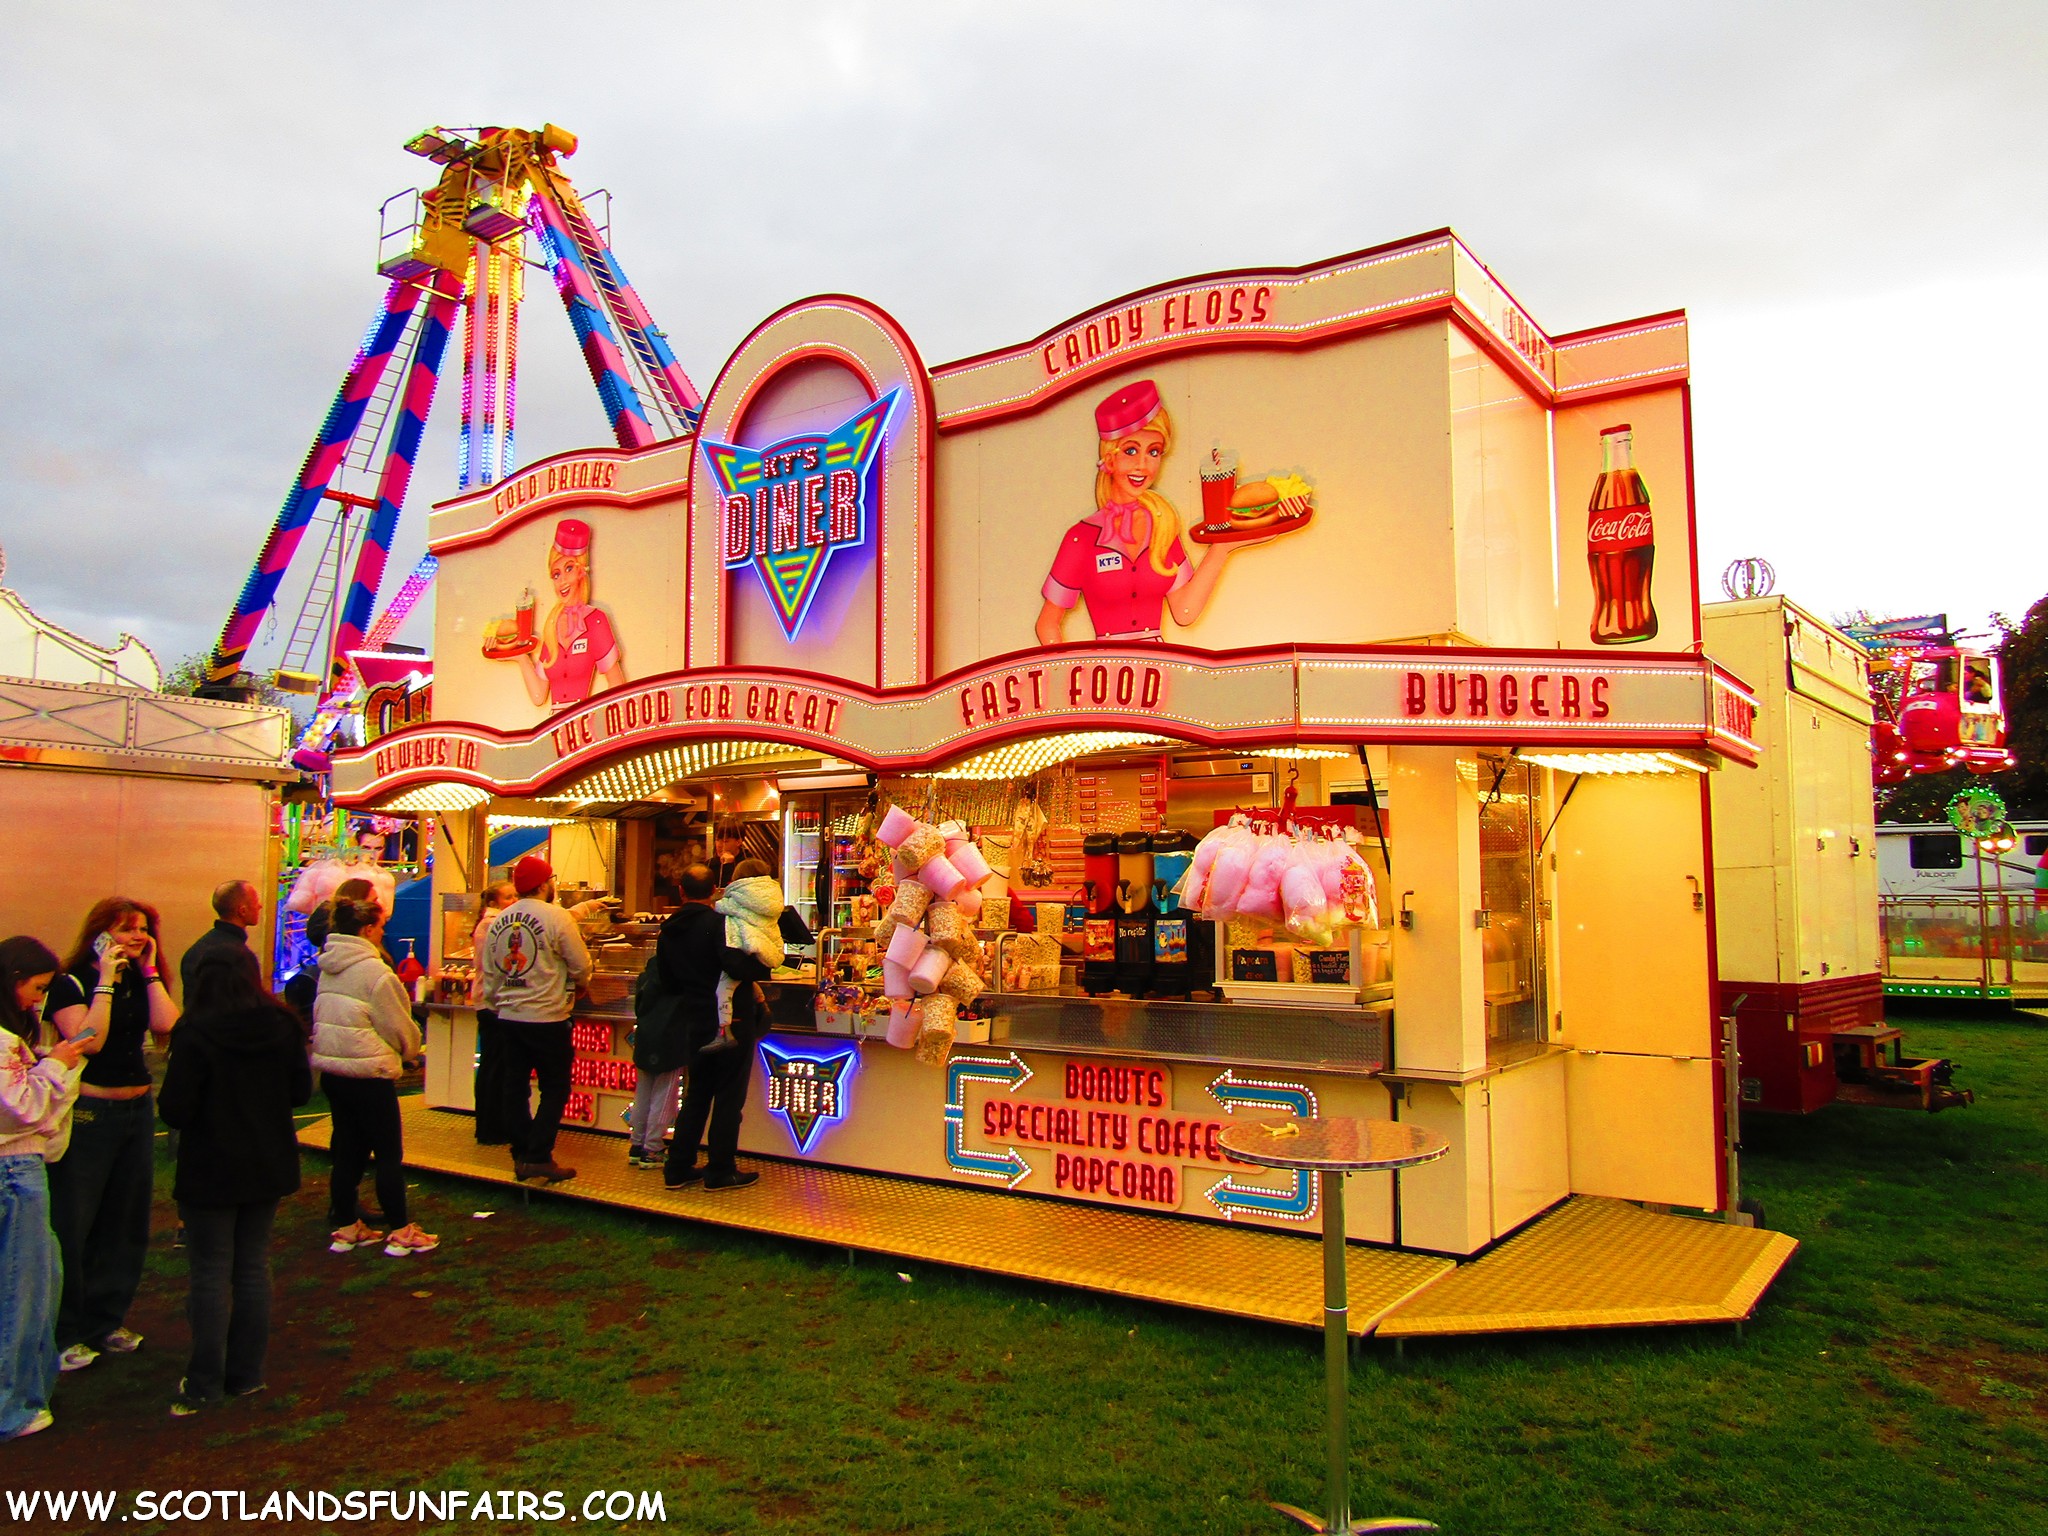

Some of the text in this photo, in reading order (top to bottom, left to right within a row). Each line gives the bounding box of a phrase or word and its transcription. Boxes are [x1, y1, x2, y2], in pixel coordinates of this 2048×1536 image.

[1044, 287, 1271, 376] CANDY FLOSS
[763, 446, 819, 479] KT'S
[495, 461, 616, 516] COLD DRINKS
[724, 469, 858, 563] DINER
[1589, 511, 1652, 542] Coca-Cola
[1098, 555, 1121, 568] KT'S
[1406, 672, 1610, 718] BURGERS
[376, 665, 1162, 778] ALWAYS IN THE MOOD FOR GREAT FAST FOOD
[768, 1075, 835, 1116] DINER
[1064, 1062, 1164, 1107] DONUTS
[983, 1100, 1241, 1164] SPECIALITY COFFE
[1055, 1153, 1175, 1205] POPCORN
